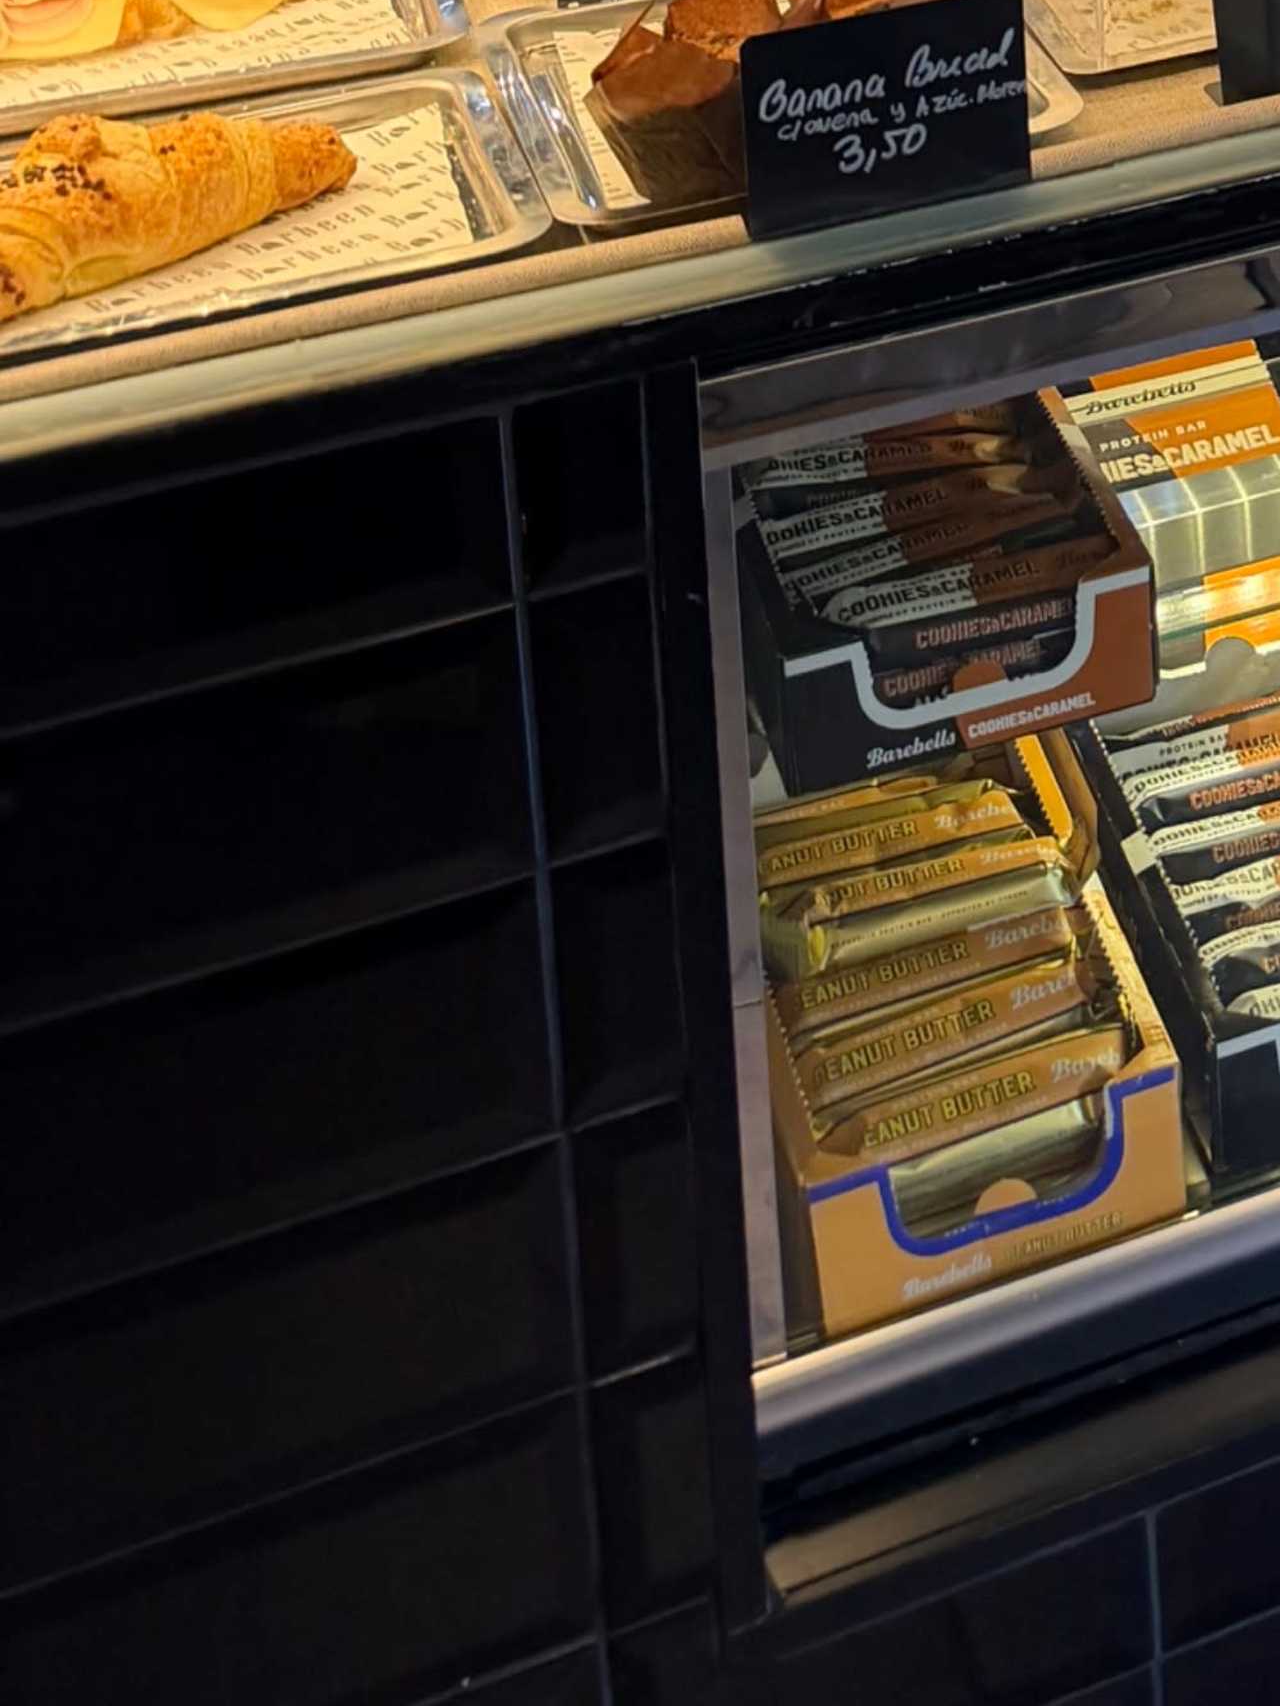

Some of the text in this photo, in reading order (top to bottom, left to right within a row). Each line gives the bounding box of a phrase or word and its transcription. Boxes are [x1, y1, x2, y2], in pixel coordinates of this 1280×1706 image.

[757, 27, 1017, 123] Banana Bread
[889, 102, 908, 124] y
[832, 124, 929, 175] 3,50
[234, 202, 376, 256] Barbeen
[236, 231, 380, 284] Barbeen
[1099, 418, 1208, 451] PROTEIN BAR
[865, 730, 957, 770] Barebells
[830, 819, 918, 854] BUTTER
[873, 858, 964, 891] BUTTER
[876, 940, 971, 982] BUTTER
[902, 1000, 995, 1051] BUTTER
[939, 1070, 1037, 1122] BUTTER
